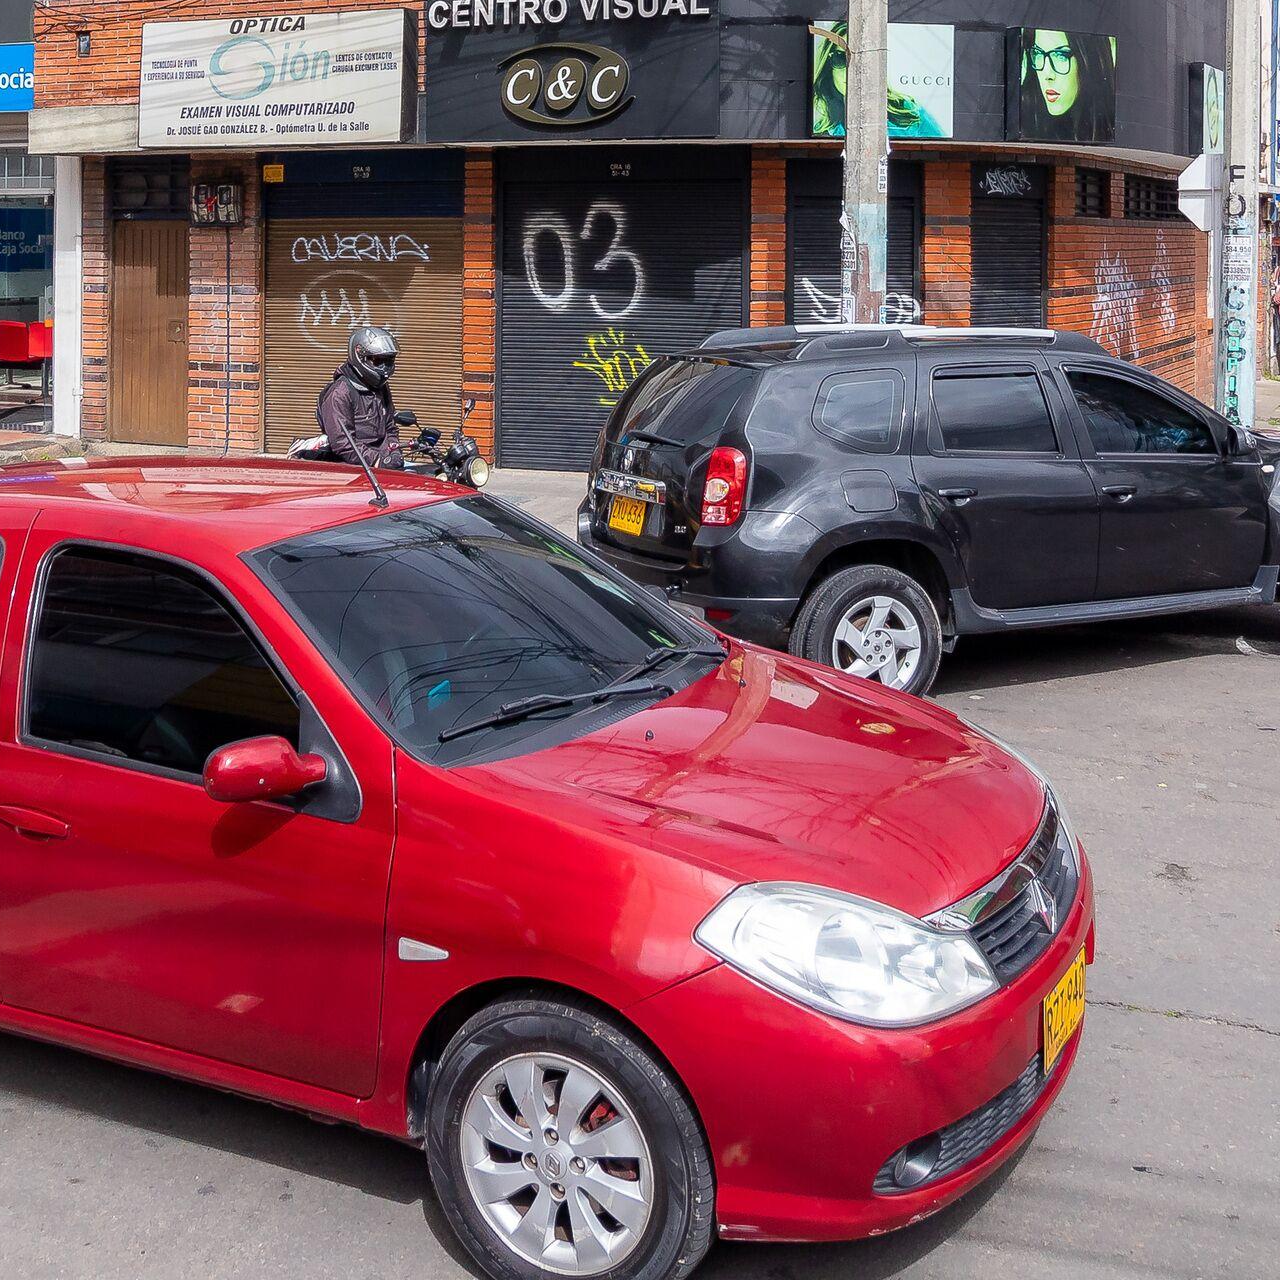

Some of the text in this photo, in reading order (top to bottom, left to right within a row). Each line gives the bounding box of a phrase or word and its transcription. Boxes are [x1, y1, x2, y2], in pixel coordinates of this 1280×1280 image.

[229, 16, 306, 34] OPTICA
[335, 51, 393, 62] LENTES DE CONTACTO
[178, 60, 184, 68] DE
[184, 59, 198, 68] PUNTA
[354, 63, 379, 72] EXCIMER
[380, 62, 398, 70] LASER
[147, 72, 174, 81] EXPERIENCIA
[178, 71, 185, 80] SU
[185, 70, 206, 80] SERVICIO
[900, 75, 950, 86] GUCCI
[180, 101, 355, 119] EXAMEN VISUAL COMPUTARIZADO
[166, 126, 177, 136] Dr.
[178, 124, 202, 135] JOSUÉ
[203, 125, 219, 135] GAD
[220, 123, 258, 135] GONZÁLEZ
[260, 124, 268, 134] B.
[275, 122, 316, 134] Optómetra
[317, 122, 326, 132] U.
[328, 122, 338, 132] de
[340, 122, 348, 131] la
